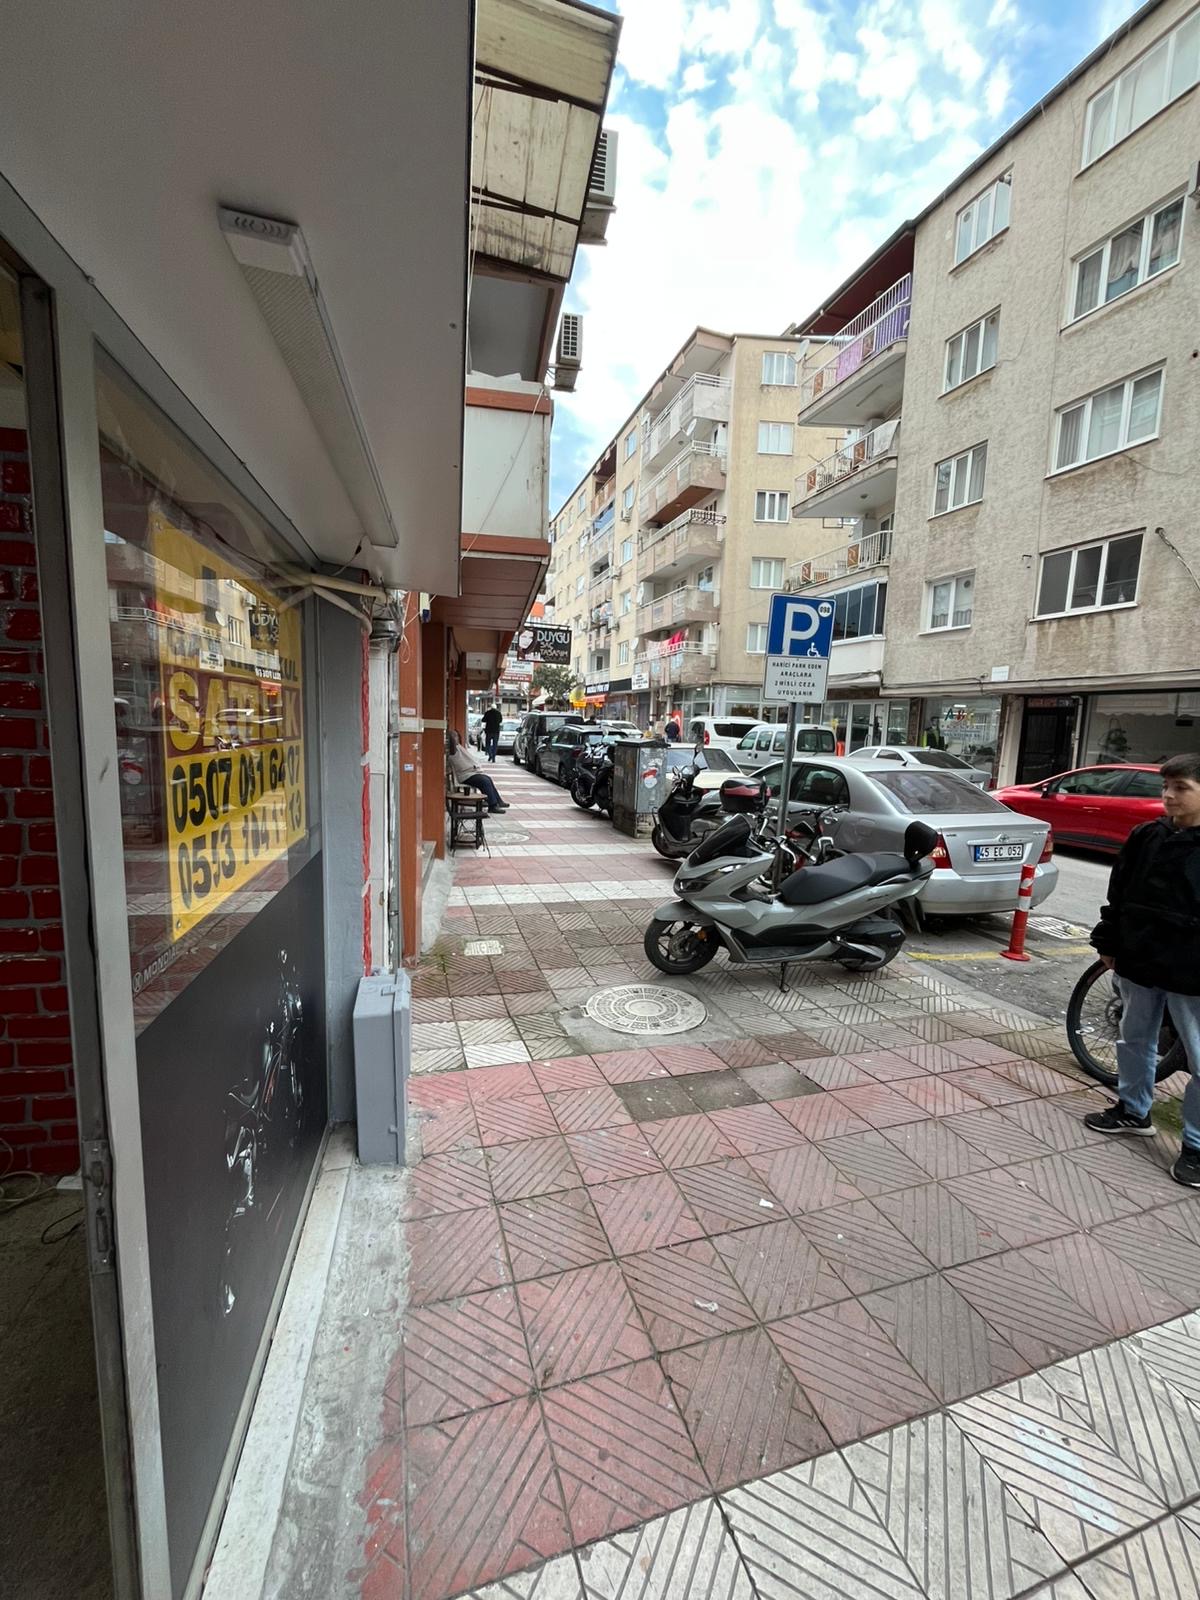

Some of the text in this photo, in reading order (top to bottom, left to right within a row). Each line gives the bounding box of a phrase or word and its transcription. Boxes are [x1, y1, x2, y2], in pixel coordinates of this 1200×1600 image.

[537, 630, 570, 644] DUYGU
[781, 602, 820, 655] P
[172, 757, 232, 834] 0507
[979, 846, 1022, 857] 45 EC 052
